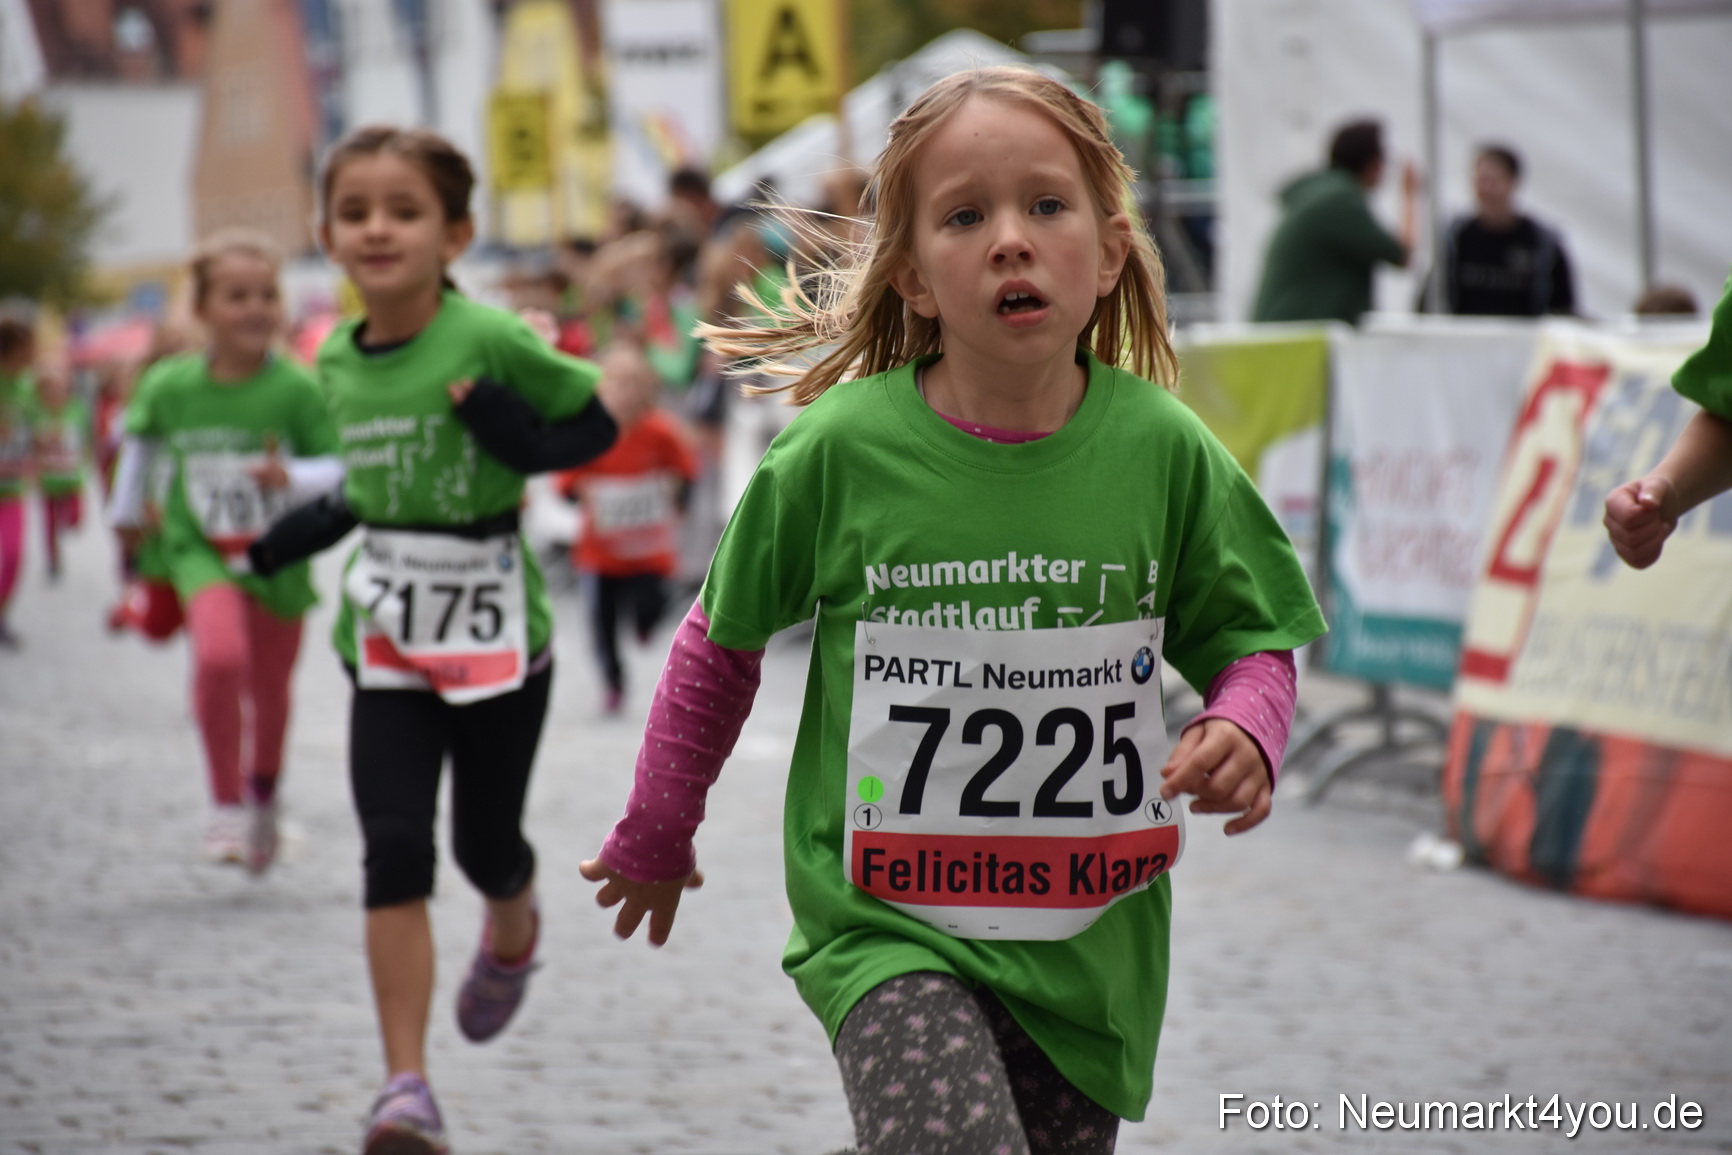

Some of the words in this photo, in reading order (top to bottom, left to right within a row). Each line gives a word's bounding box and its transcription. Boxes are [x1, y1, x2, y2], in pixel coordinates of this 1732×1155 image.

[758, 6, 821, 80] A
[865, 551, 1086, 595] Neumarkter
[369, 576, 504, 644] 7175
[870, 597, 1041, 631] stadtlauf
[865, 654, 973, 689] PARTL
[983, 657, 1123, 690] Neumarkt
[888, 701, 1144, 818] 7225
[862, 807, 871, 827] 1
[1151, 801, 1167, 821] K
[862, 847, 1051, 894] Felicitas
[1068, 852, 1168, 896] Klara
